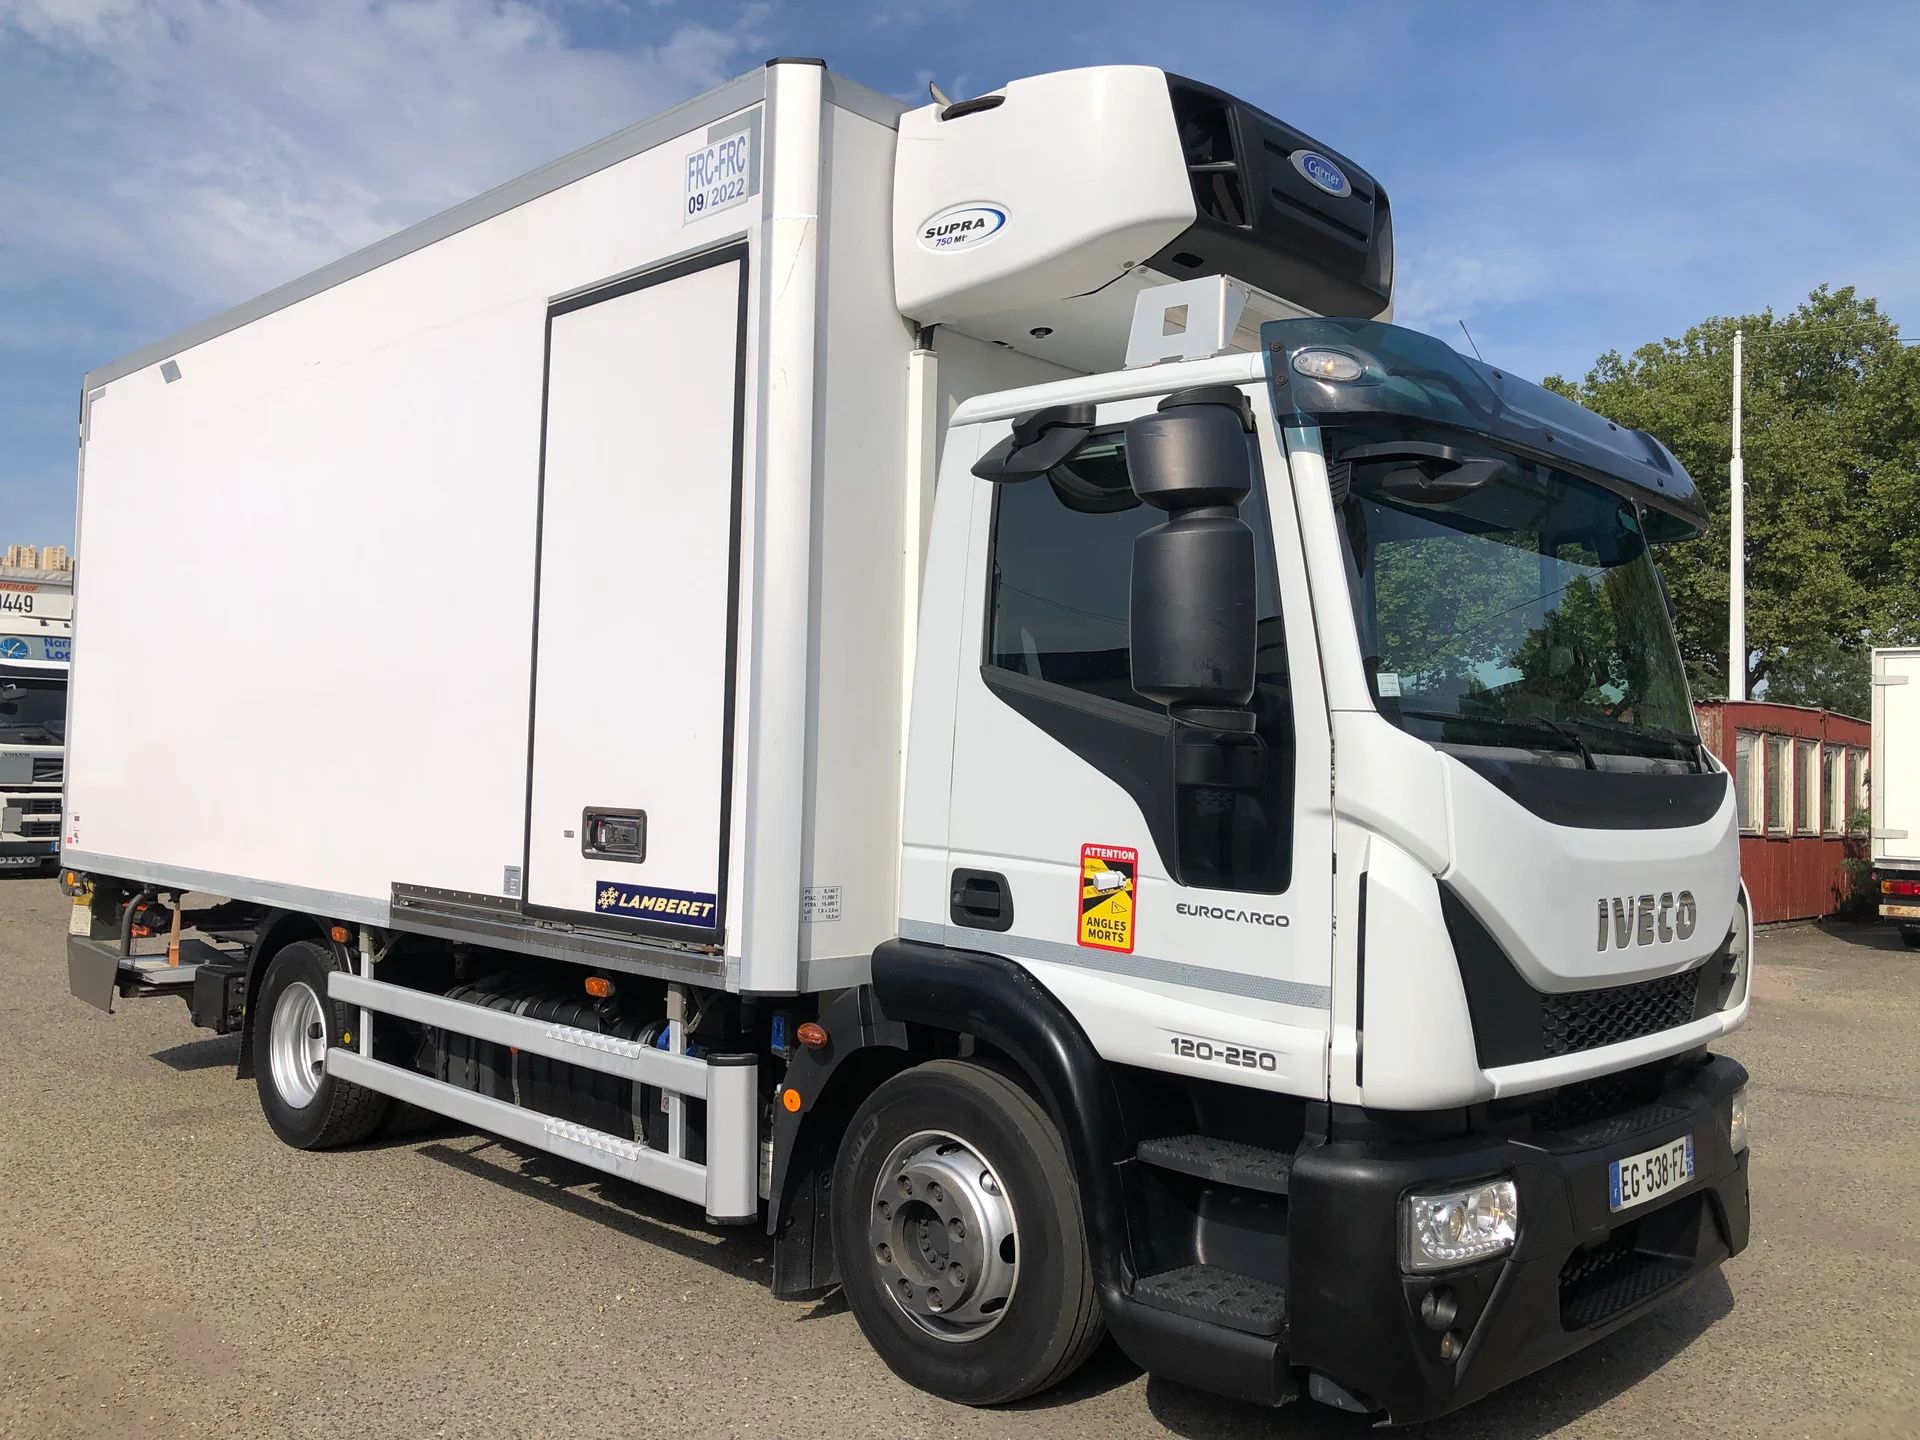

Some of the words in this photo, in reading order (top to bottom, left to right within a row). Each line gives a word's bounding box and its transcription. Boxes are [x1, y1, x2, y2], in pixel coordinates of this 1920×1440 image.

[688, 136, 746, 192] FRC-FRC
[1308, 160, 1340, 186] Carrier
[925, 217, 985, 239] SUPRA
[935, 237, 953, 247] 750
[0, 593, 33, 613] 449
[1084, 846, 1135, 861] ATTENTION
[619, 893, 715, 918] LAMBERET
[1176, 903, 1290, 928] EUROCARGO
[1086, 916, 1127, 931] ANGLES
[1597, 890, 1697, 953] IVECO
[1088, 928, 1124, 943] MORTS
[1170, 1037, 1277, 1072] 120-250
[1621, 1144, 1686, 1202] EG-538-FZ
